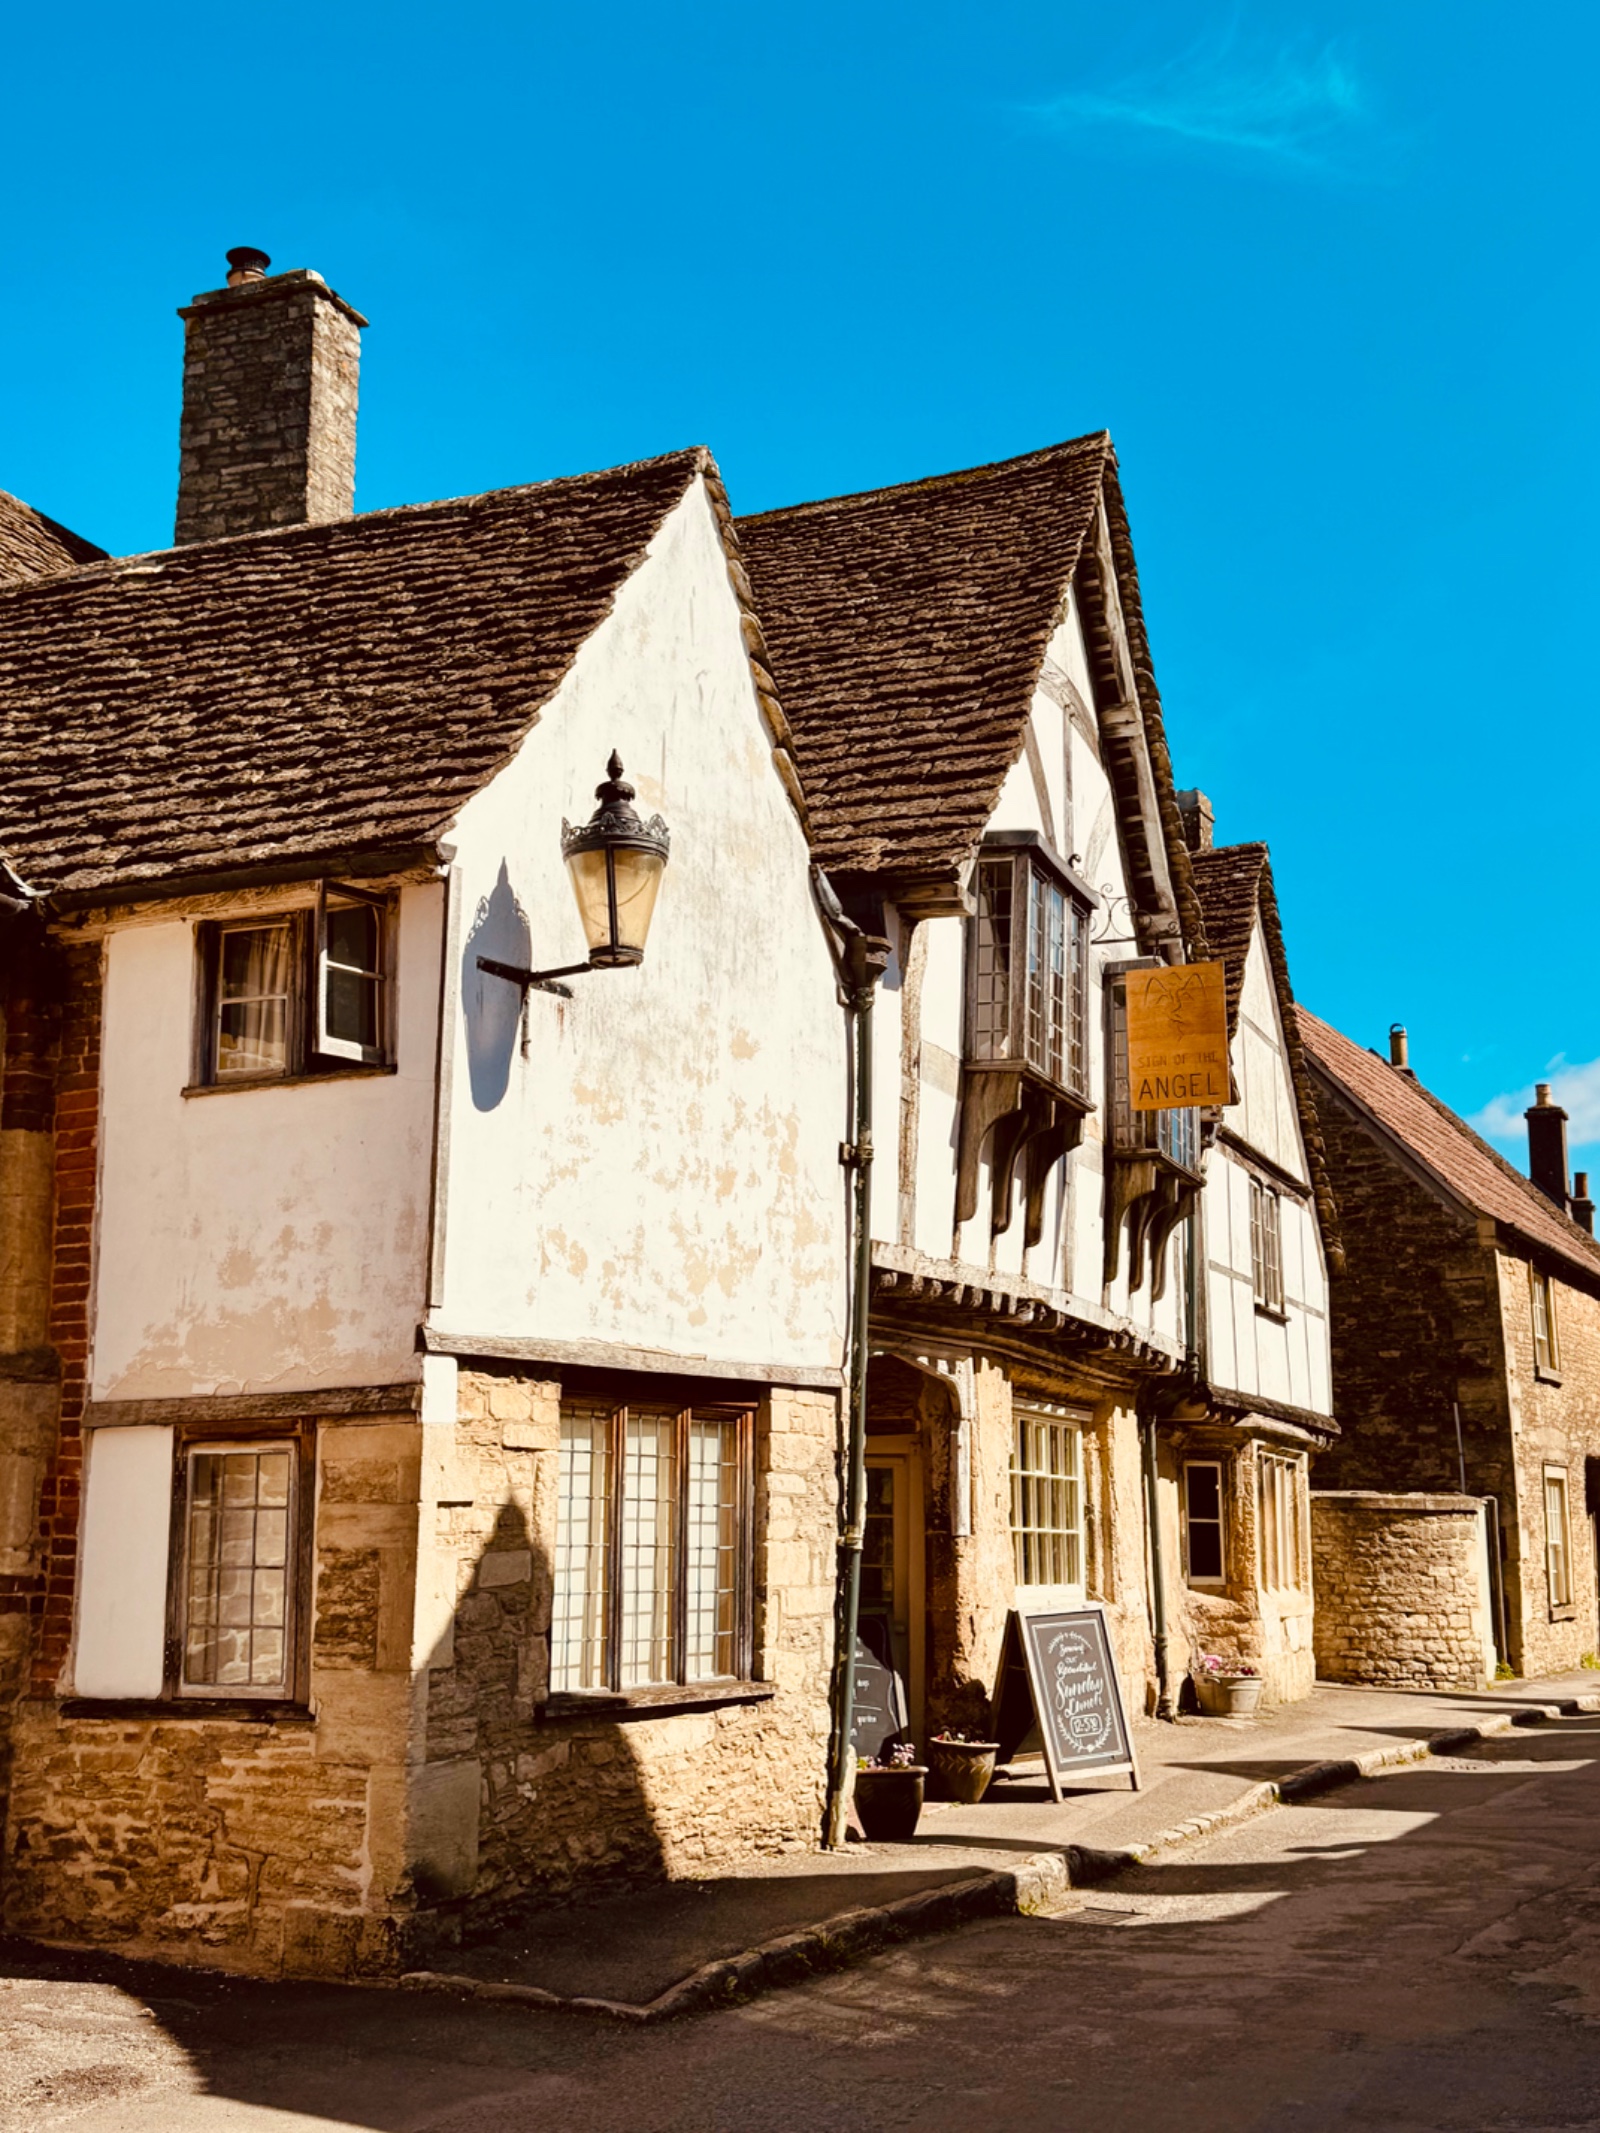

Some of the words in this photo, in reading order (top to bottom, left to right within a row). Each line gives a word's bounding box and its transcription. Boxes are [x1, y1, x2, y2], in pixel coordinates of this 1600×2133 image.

[1137, 1055, 1167, 1068] SIGN
[1174, 1054, 1186, 1065] OF
[1198, 1051, 1218, 1063] THE
[1138, 1072, 1220, 1101] ANGEL
[1056, 1674, 1103, 1710] Sunday
[1064, 1691, 1103, 1718] Lunch
